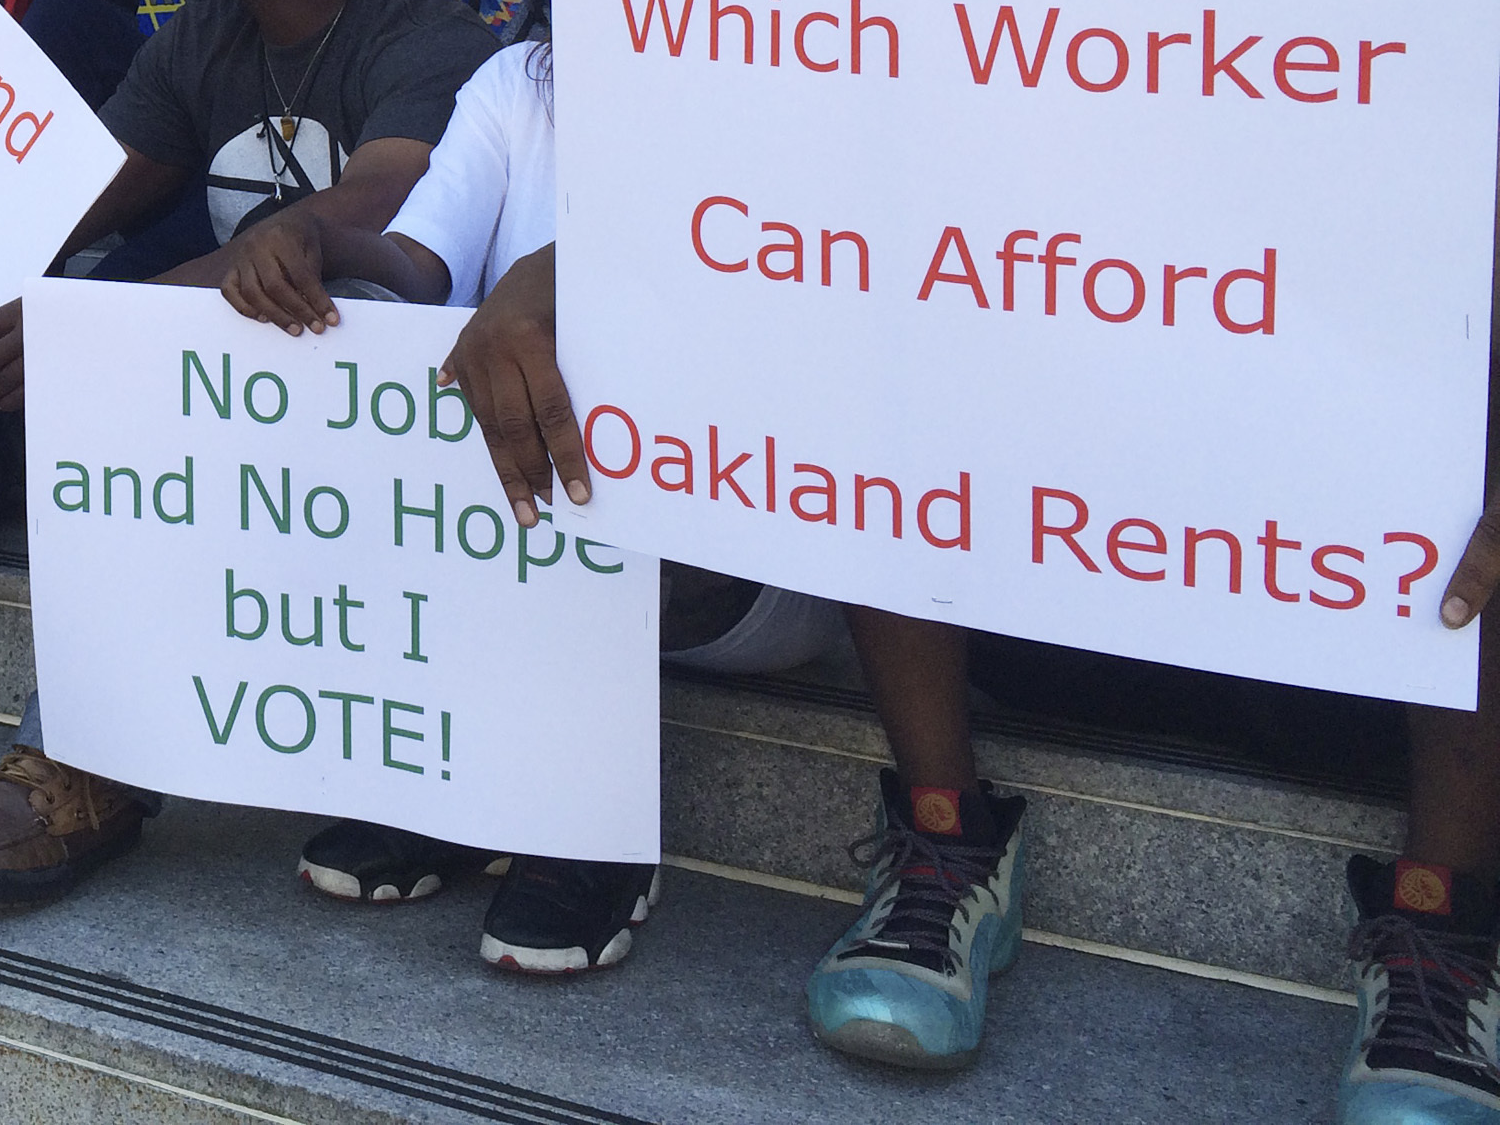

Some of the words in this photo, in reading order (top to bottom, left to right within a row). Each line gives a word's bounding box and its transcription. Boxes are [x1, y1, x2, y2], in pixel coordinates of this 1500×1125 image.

[953, 2, 1408, 106] Worker
[689, 195, 871, 293] Can
[917, 224, 1278, 337] Afford
[181, 349, 290, 425] No
[326, 360, 475, 443] Job
[52, 455, 196, 526] and
[240, 463, 350, 540] No
[583, 403, 972, 553] Oakland
[1031, 484, 1439, 619] Rents?
[225, 568, 366, 653] but
[402, 590, 429, 664] I
[191, 674, 452, 782] VOTE!
